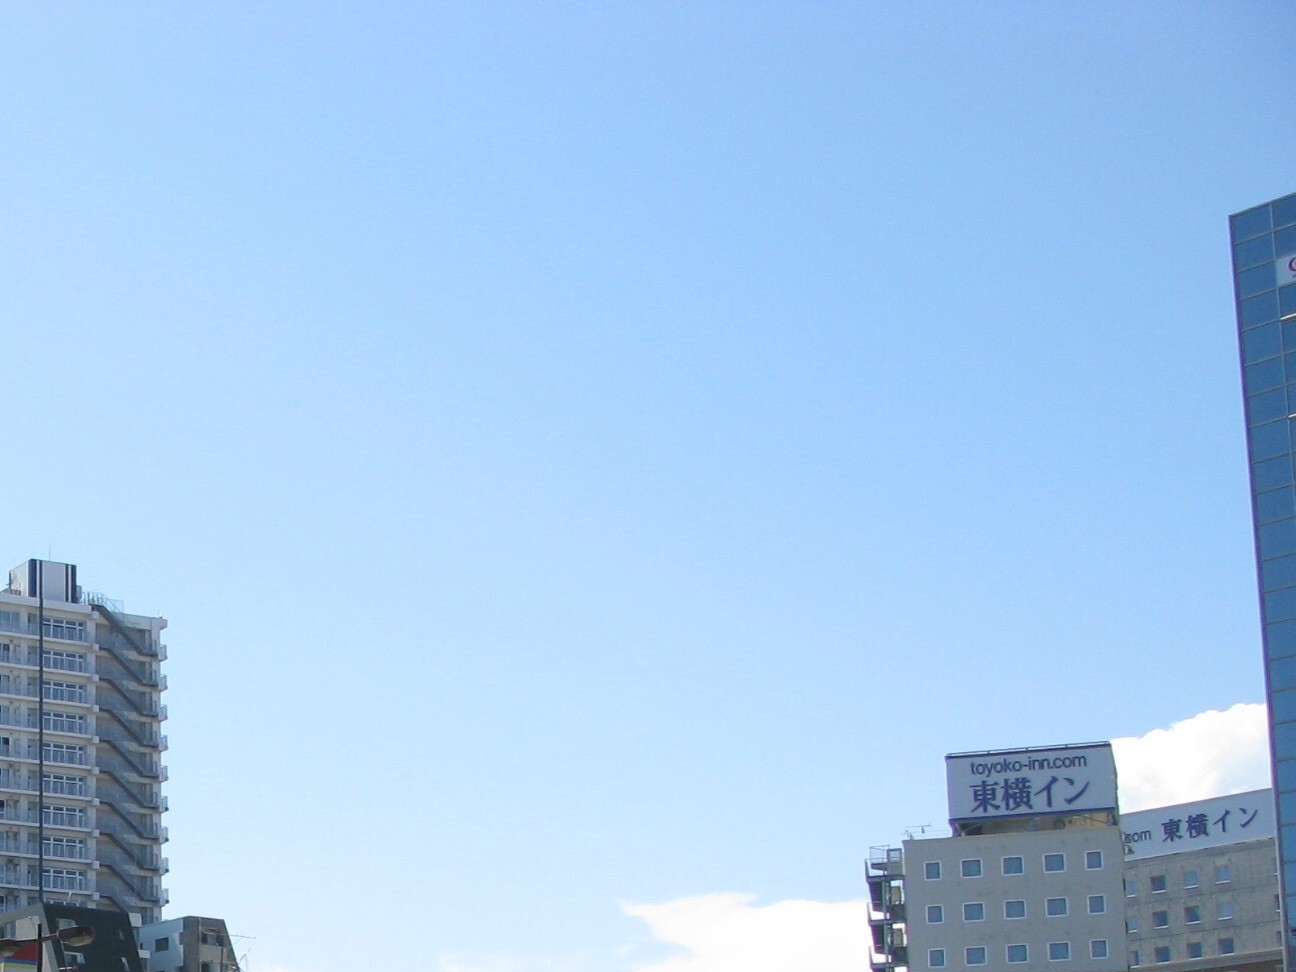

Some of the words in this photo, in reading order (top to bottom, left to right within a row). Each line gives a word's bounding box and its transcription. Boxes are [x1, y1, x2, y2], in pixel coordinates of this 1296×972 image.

[970, 756, 1087, 778] toyoko-inn.com
[969, 775, 1090, 813] 東横イン
[1161, 808, 1258, 842] 東横イン
